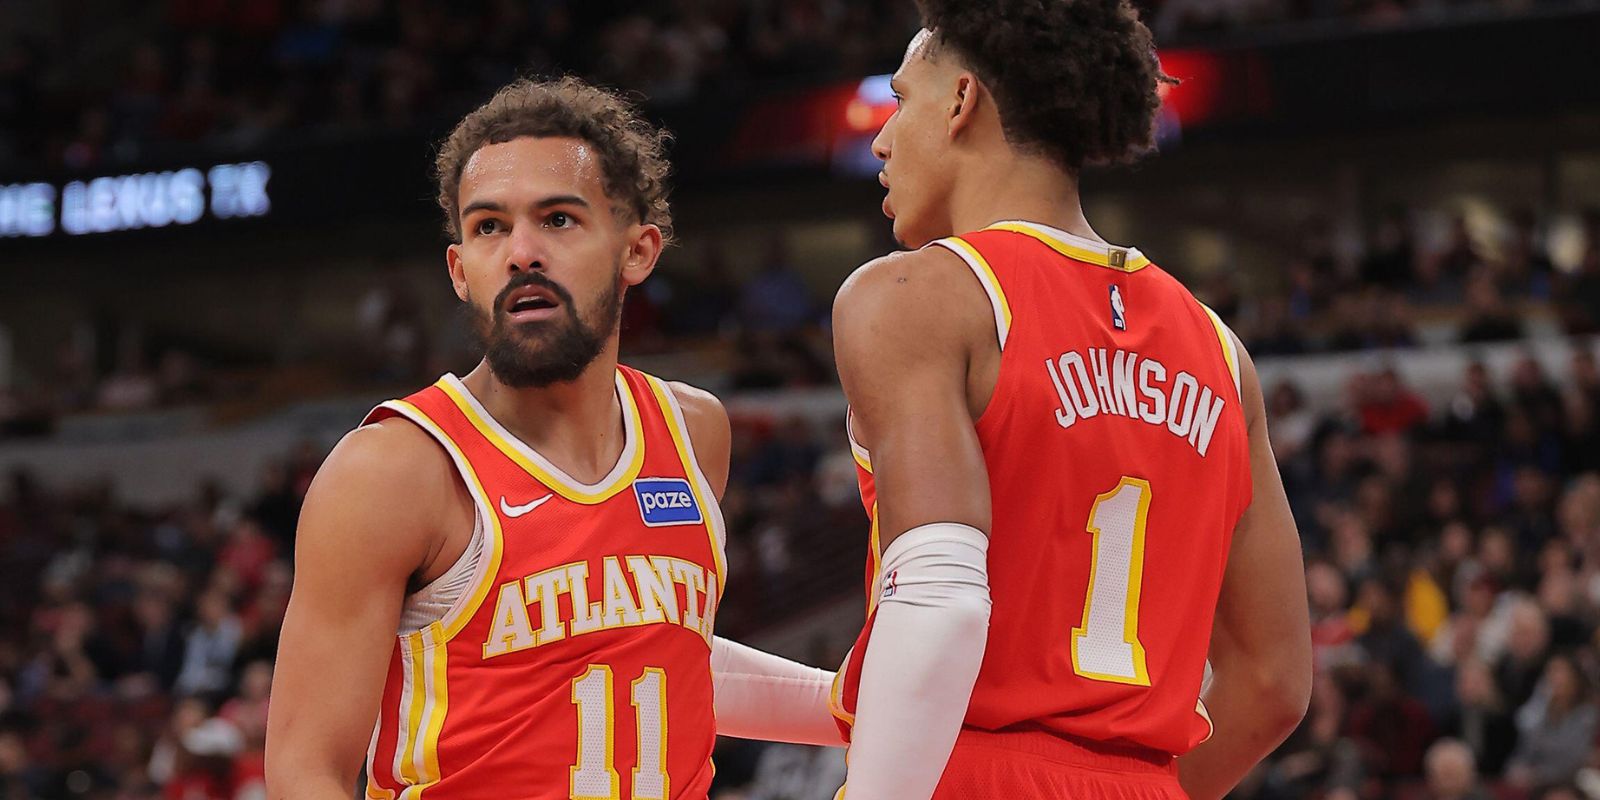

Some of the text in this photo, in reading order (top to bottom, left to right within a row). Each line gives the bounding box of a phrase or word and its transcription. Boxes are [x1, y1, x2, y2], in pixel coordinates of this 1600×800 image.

[61, 169, 204, 234] LEXUS
[1045, 347, 1225, 458] JOHNSON
[641, 492, 692, 514] paze
[482, 555, 717, 660] ATLANTA
[1070, 475, 1152, 687] 1
[569, 664, 671, 800] 11
